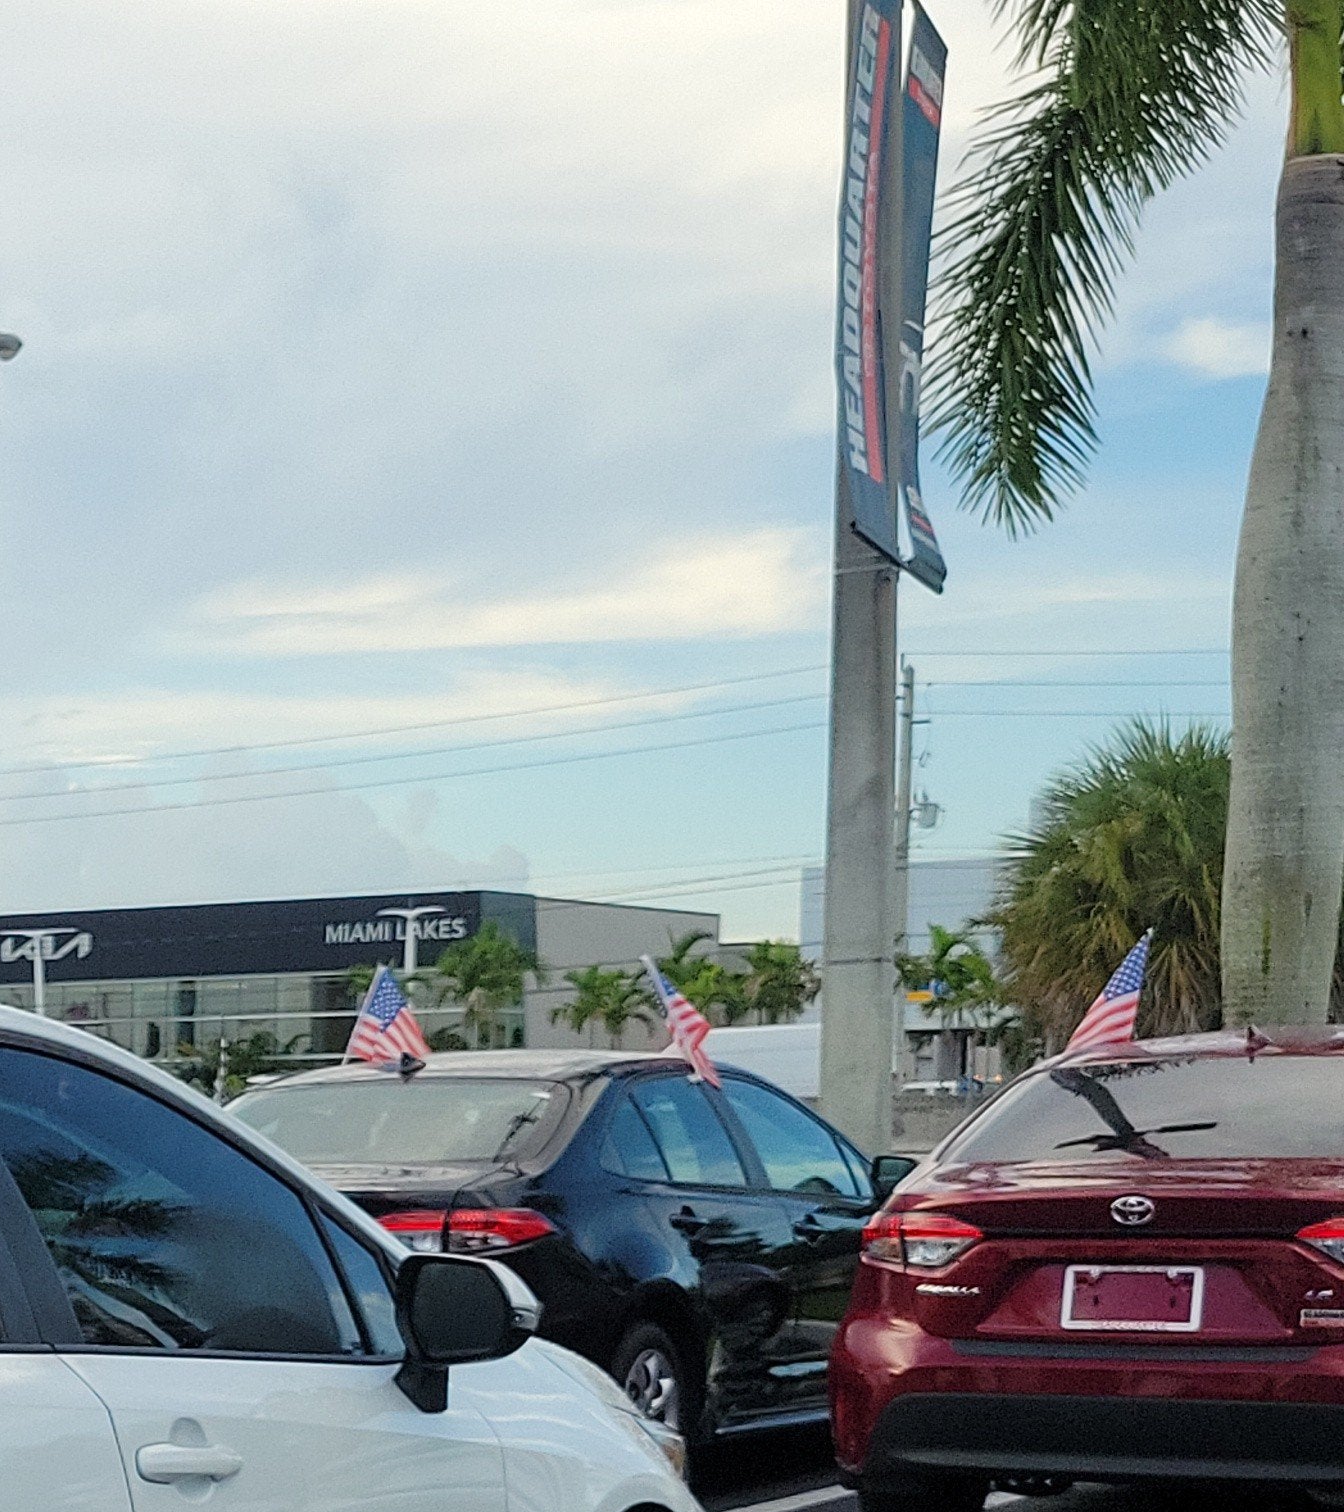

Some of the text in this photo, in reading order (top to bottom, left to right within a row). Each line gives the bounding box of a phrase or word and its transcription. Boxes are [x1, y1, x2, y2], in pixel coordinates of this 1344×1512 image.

[844, 4, 880, 475] HEADQUARTER
[325, 917, 467, 944] MIAMI LAKES
